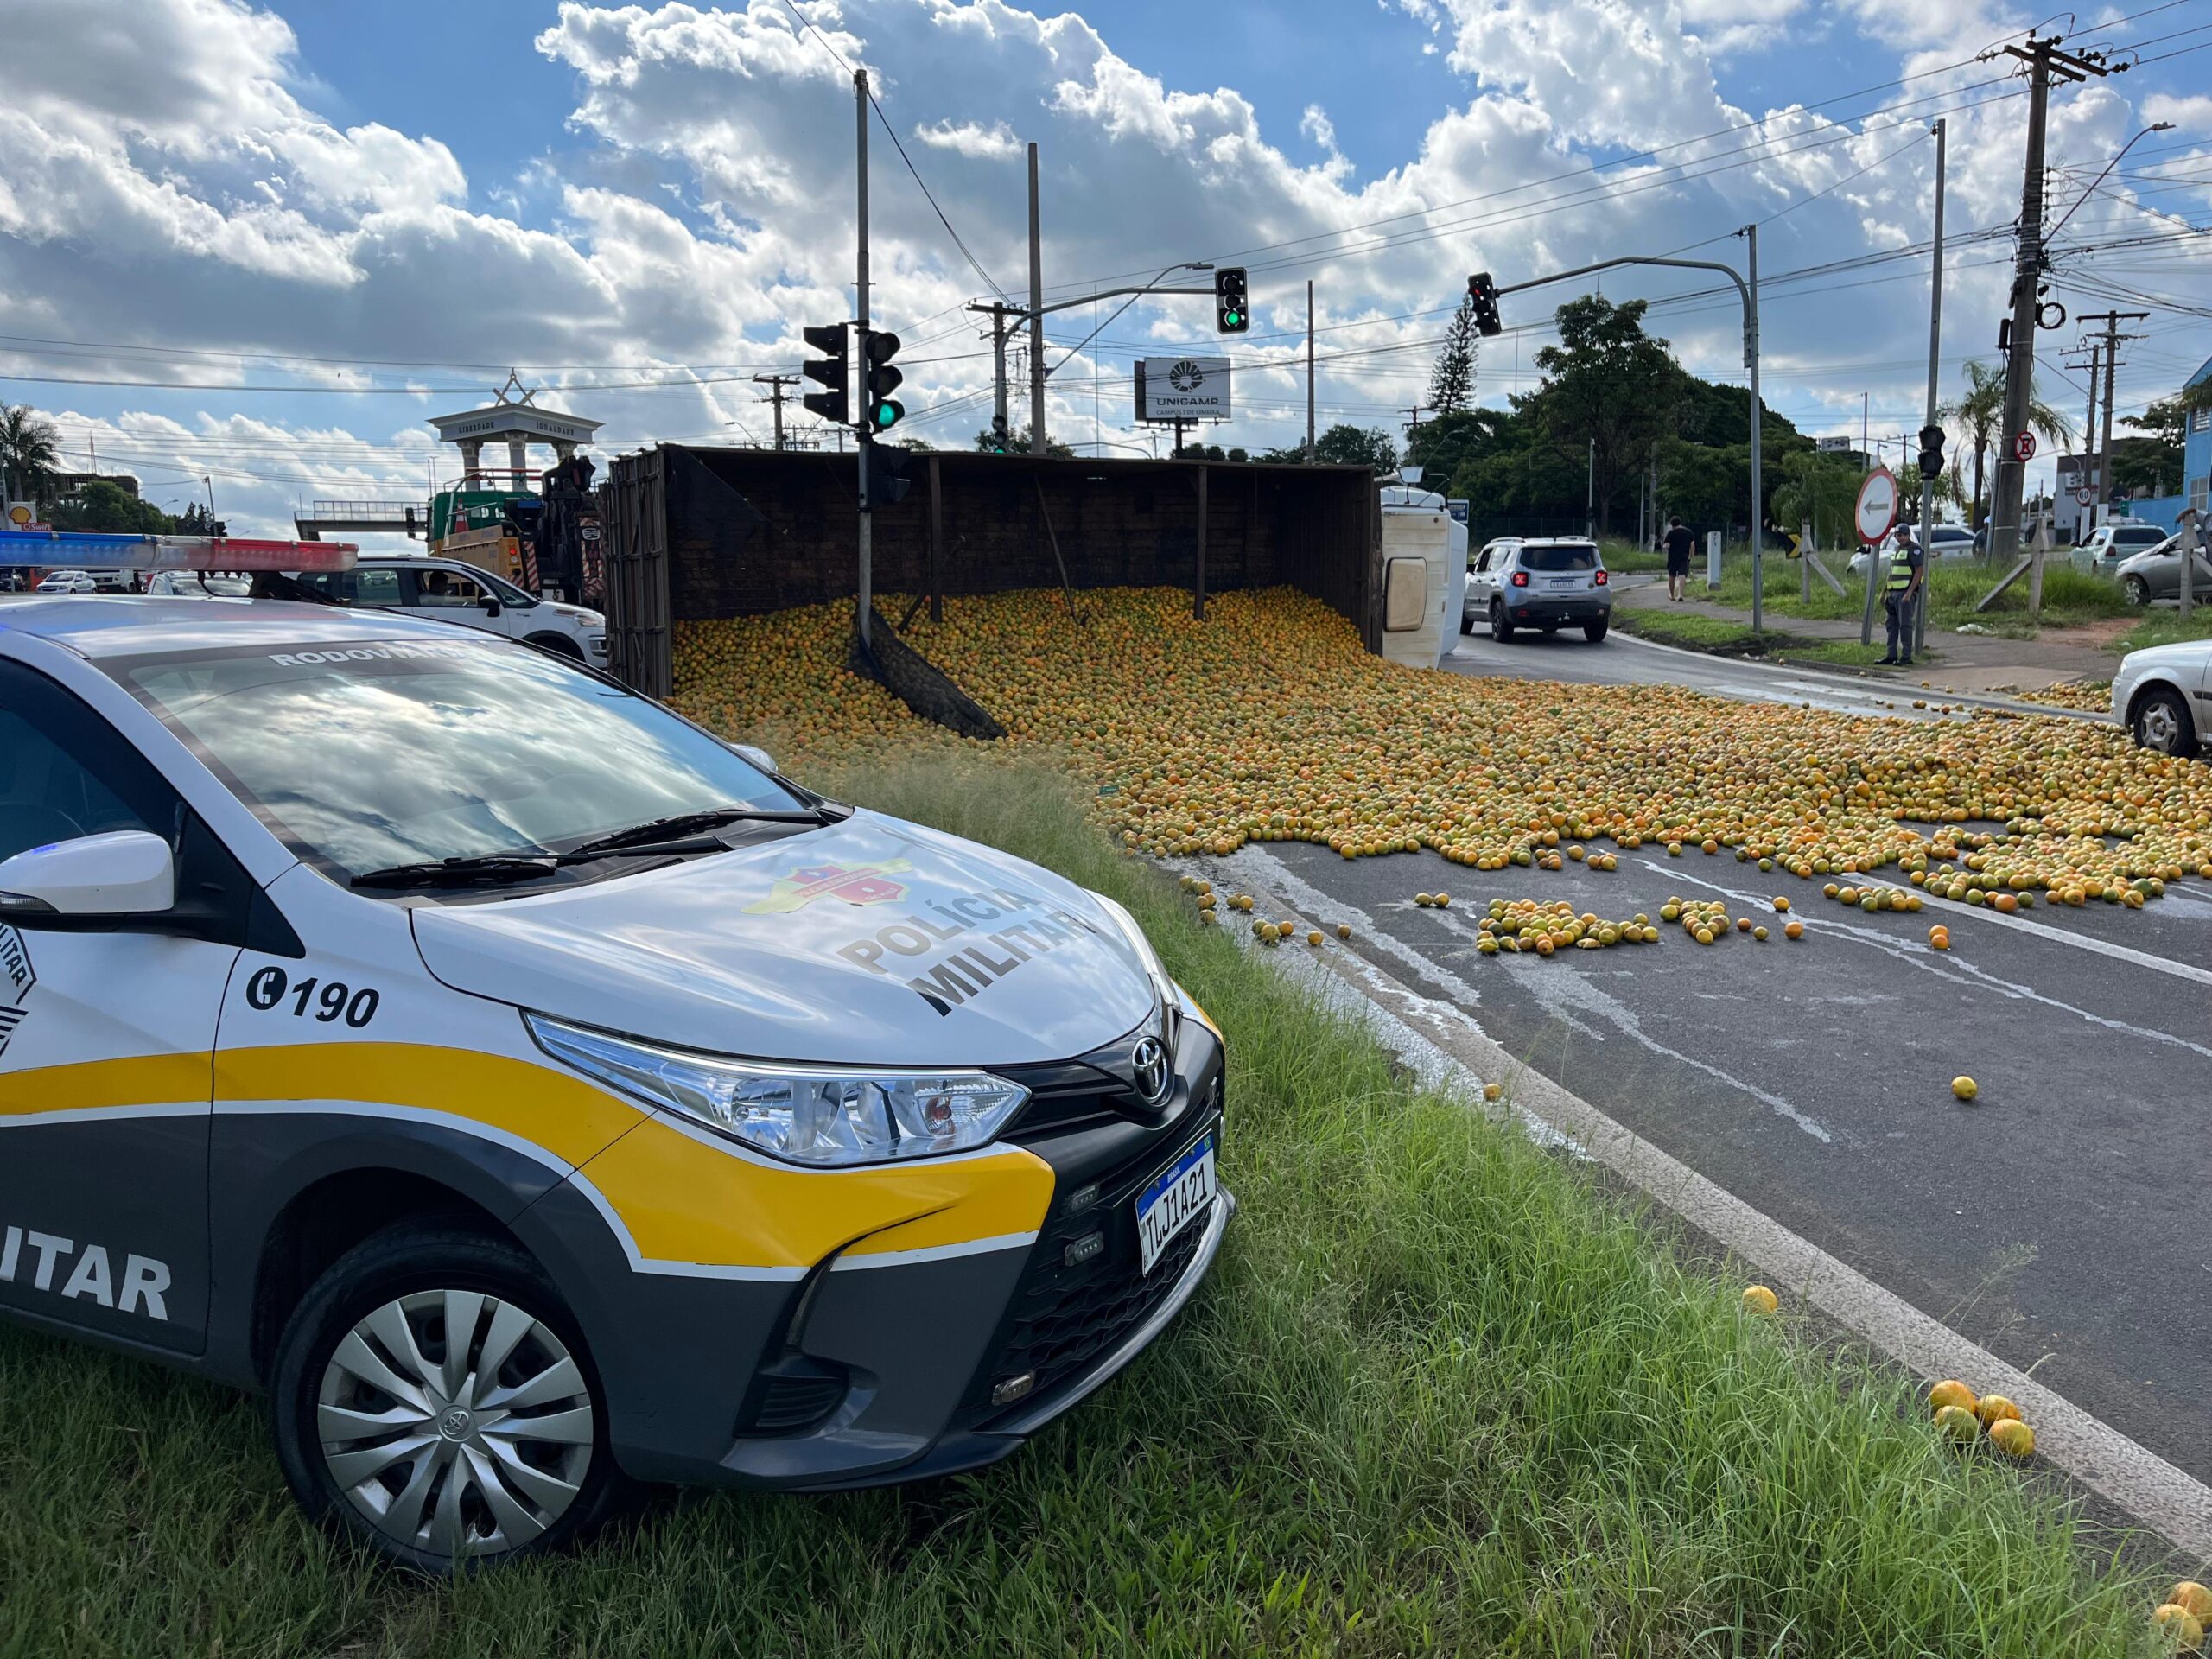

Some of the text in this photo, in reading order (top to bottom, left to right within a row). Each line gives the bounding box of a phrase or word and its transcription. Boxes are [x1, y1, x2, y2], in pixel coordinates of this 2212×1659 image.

[1157, 397, 1218, 406] UNICAMP
[458, 421, 495, 434] LIBERDADE
[536, 421, 575, 436] IGUALDADE
[2079, 491, 2089, 499] 60
[836, 887, 1044, 975] POLÍCIA
[906, 910, 1098, 1018] MILITAR
[292, 977, 380, 1028] 190
[1146, 1162, 1208, 1257] TLJ1A21
